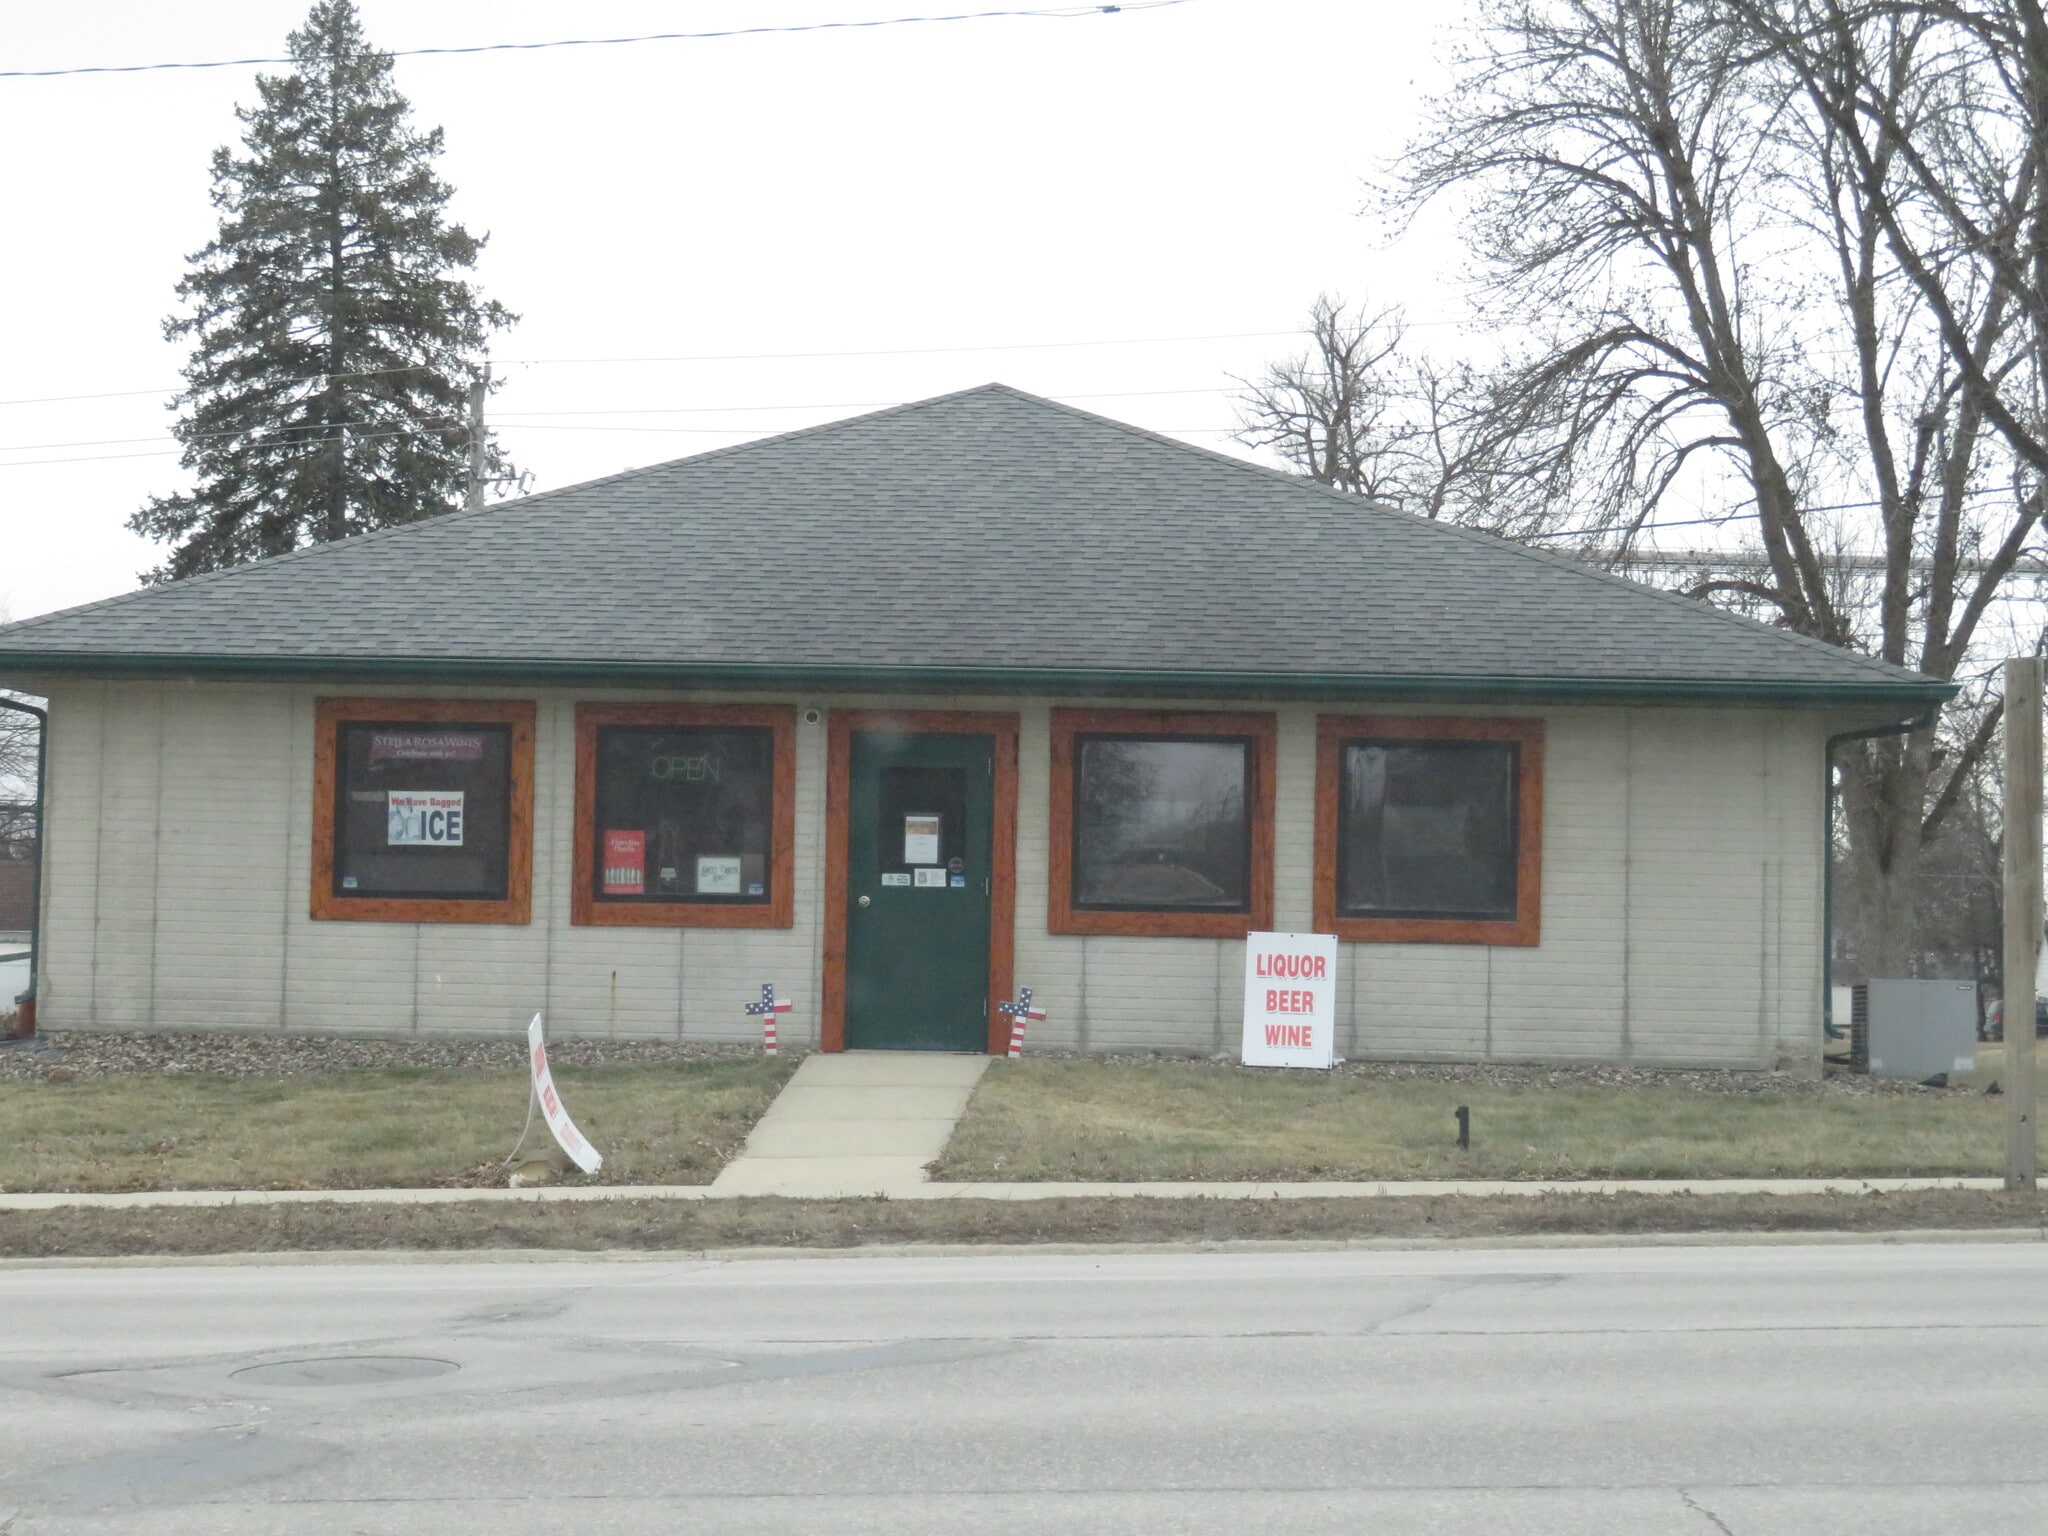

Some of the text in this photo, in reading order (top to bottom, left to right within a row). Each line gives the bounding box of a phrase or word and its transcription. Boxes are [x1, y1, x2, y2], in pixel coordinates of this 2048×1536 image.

[375, 736, 481, 748] STELLA ROSA WINES
[650, 755, 721, 780] OPEN
[391, 797, 462, 809] We Have Bagged
[420, 810, 461, 841] ICE
[1256, 953, 1327, 979] LIQUOR
[1265, 989, 1314, 1013] BEER
[1264, 1024, 1313, 1047] WINE
